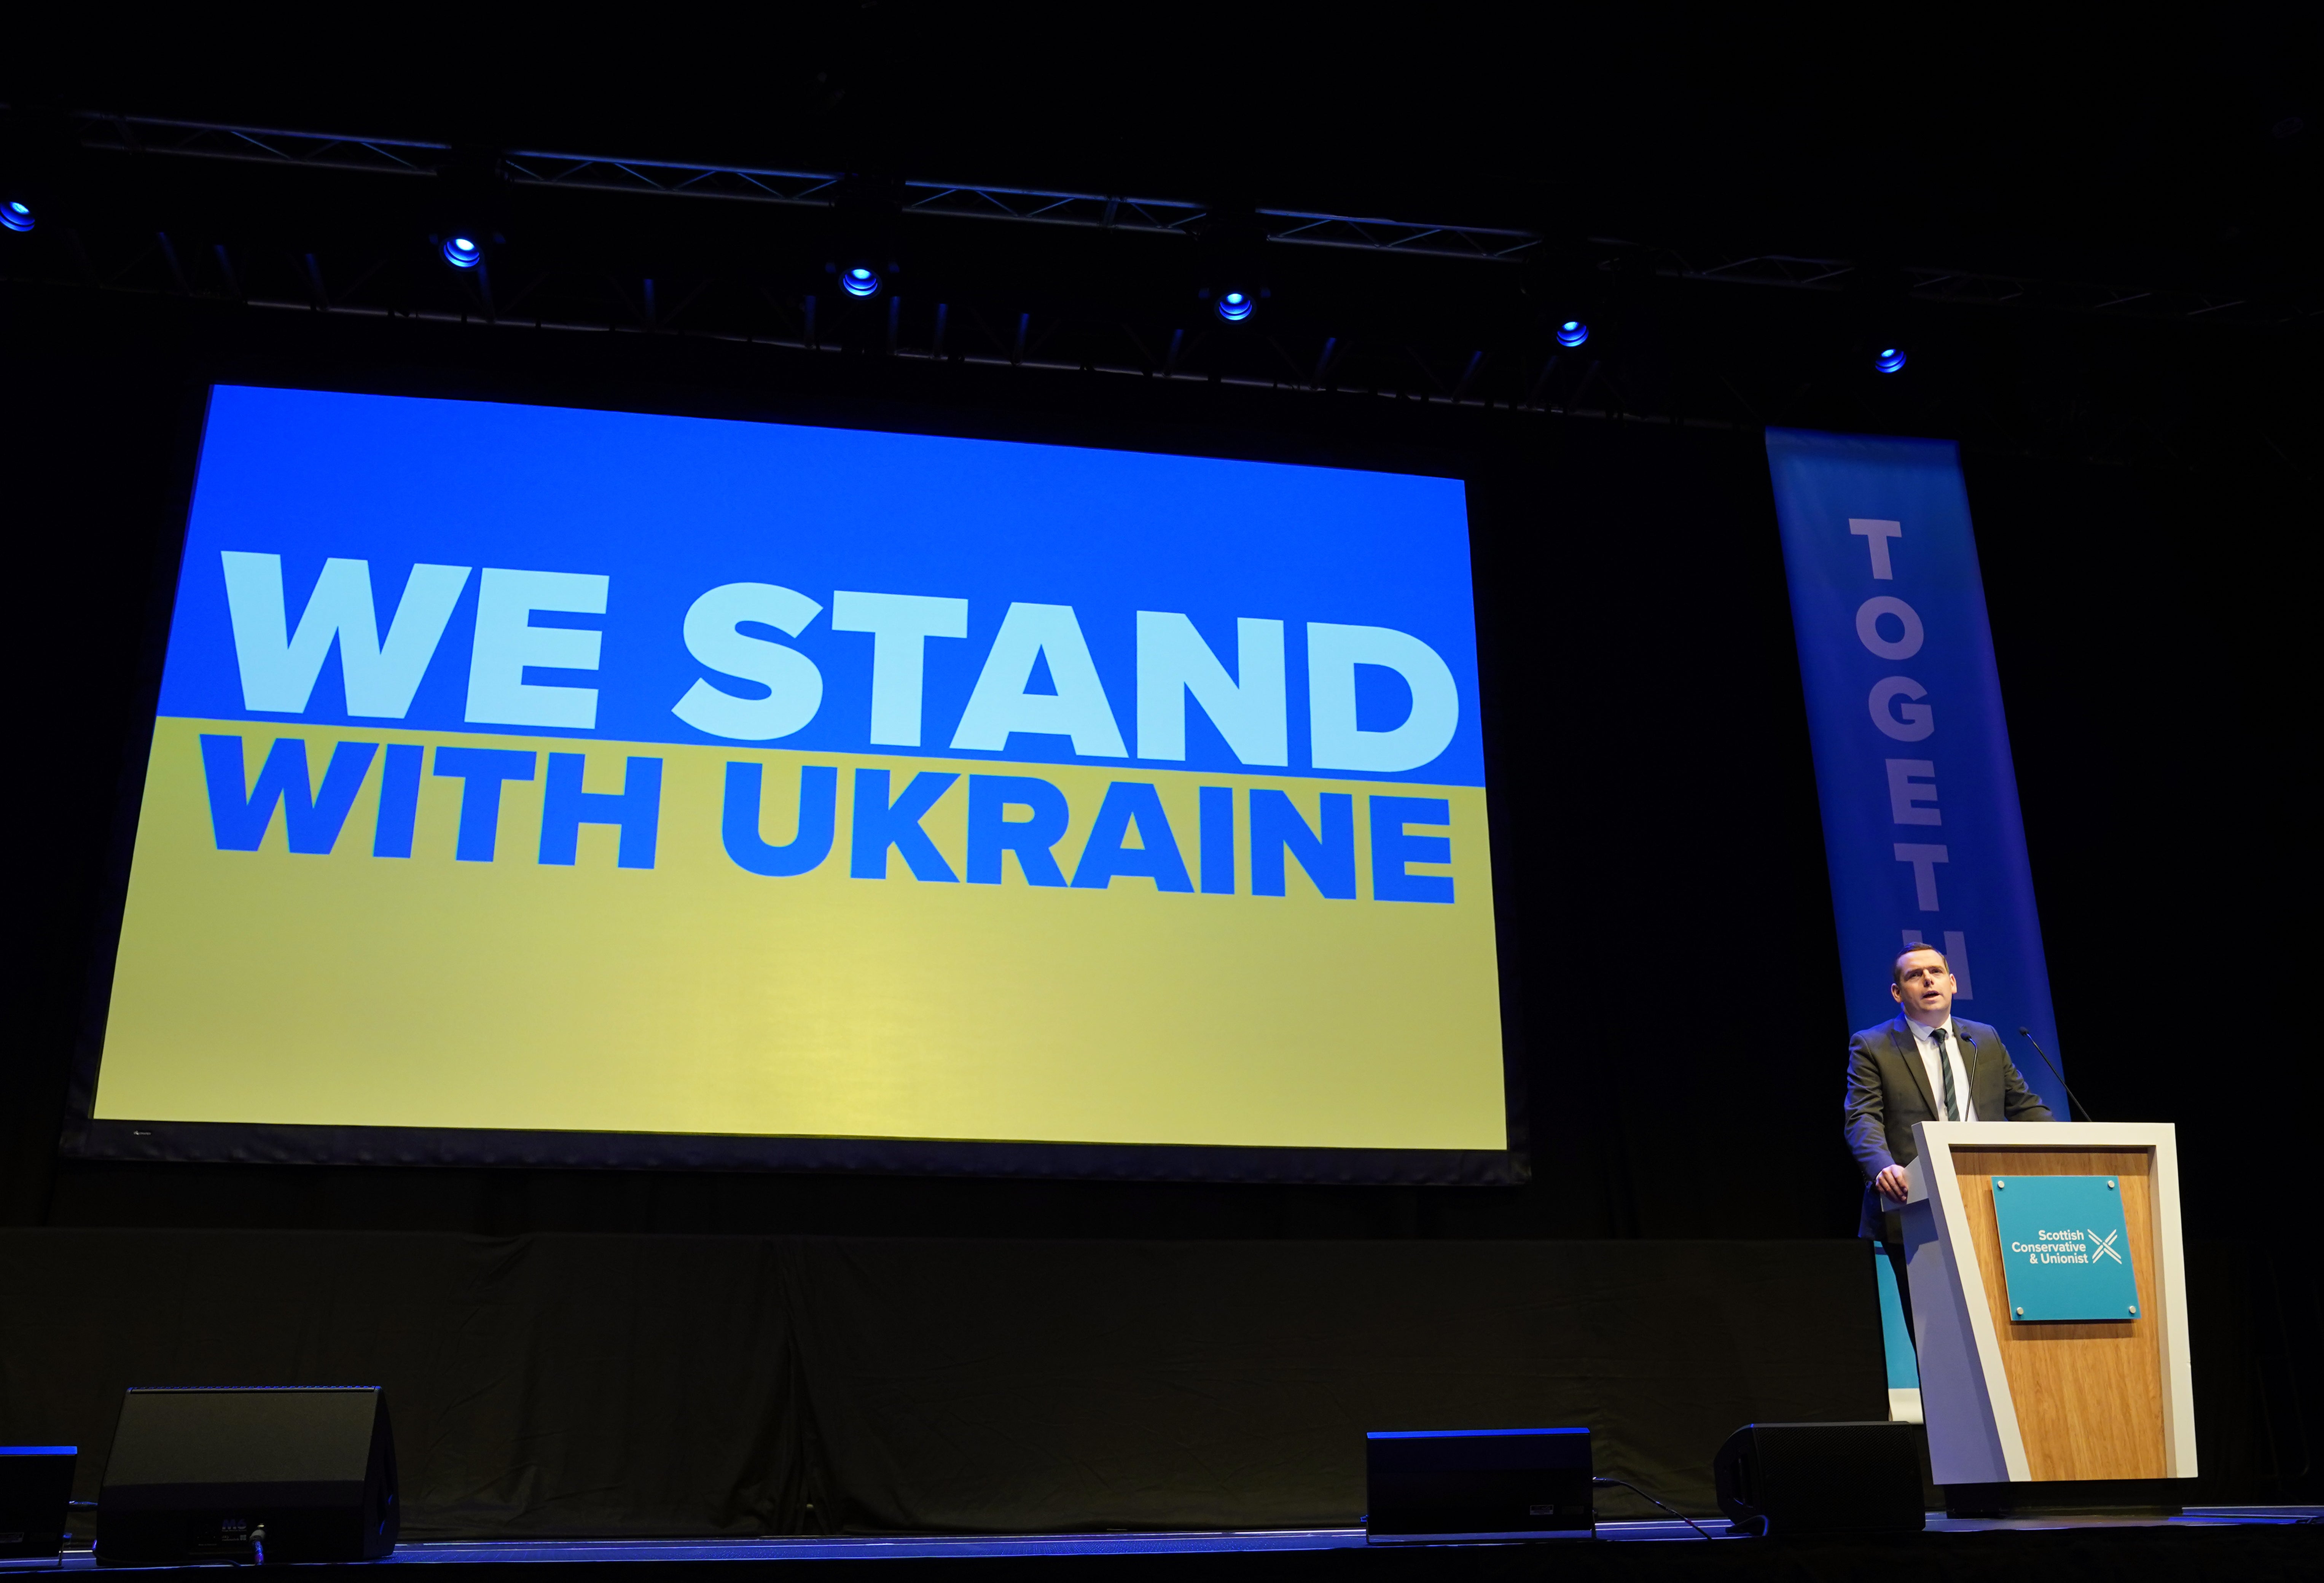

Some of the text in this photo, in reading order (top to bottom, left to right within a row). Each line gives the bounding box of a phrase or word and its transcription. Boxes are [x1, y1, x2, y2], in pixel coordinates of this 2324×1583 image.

[221, 551, 1459, 772] WE STAND
[199, 734, 1455, 904] WITH UKRAINE
[2039, 1230, 2084, 1240] Scottish
[2012, 1241, 2086, 1253] Conservative
[2029, 1253, 2088, 1264] & Unionist
